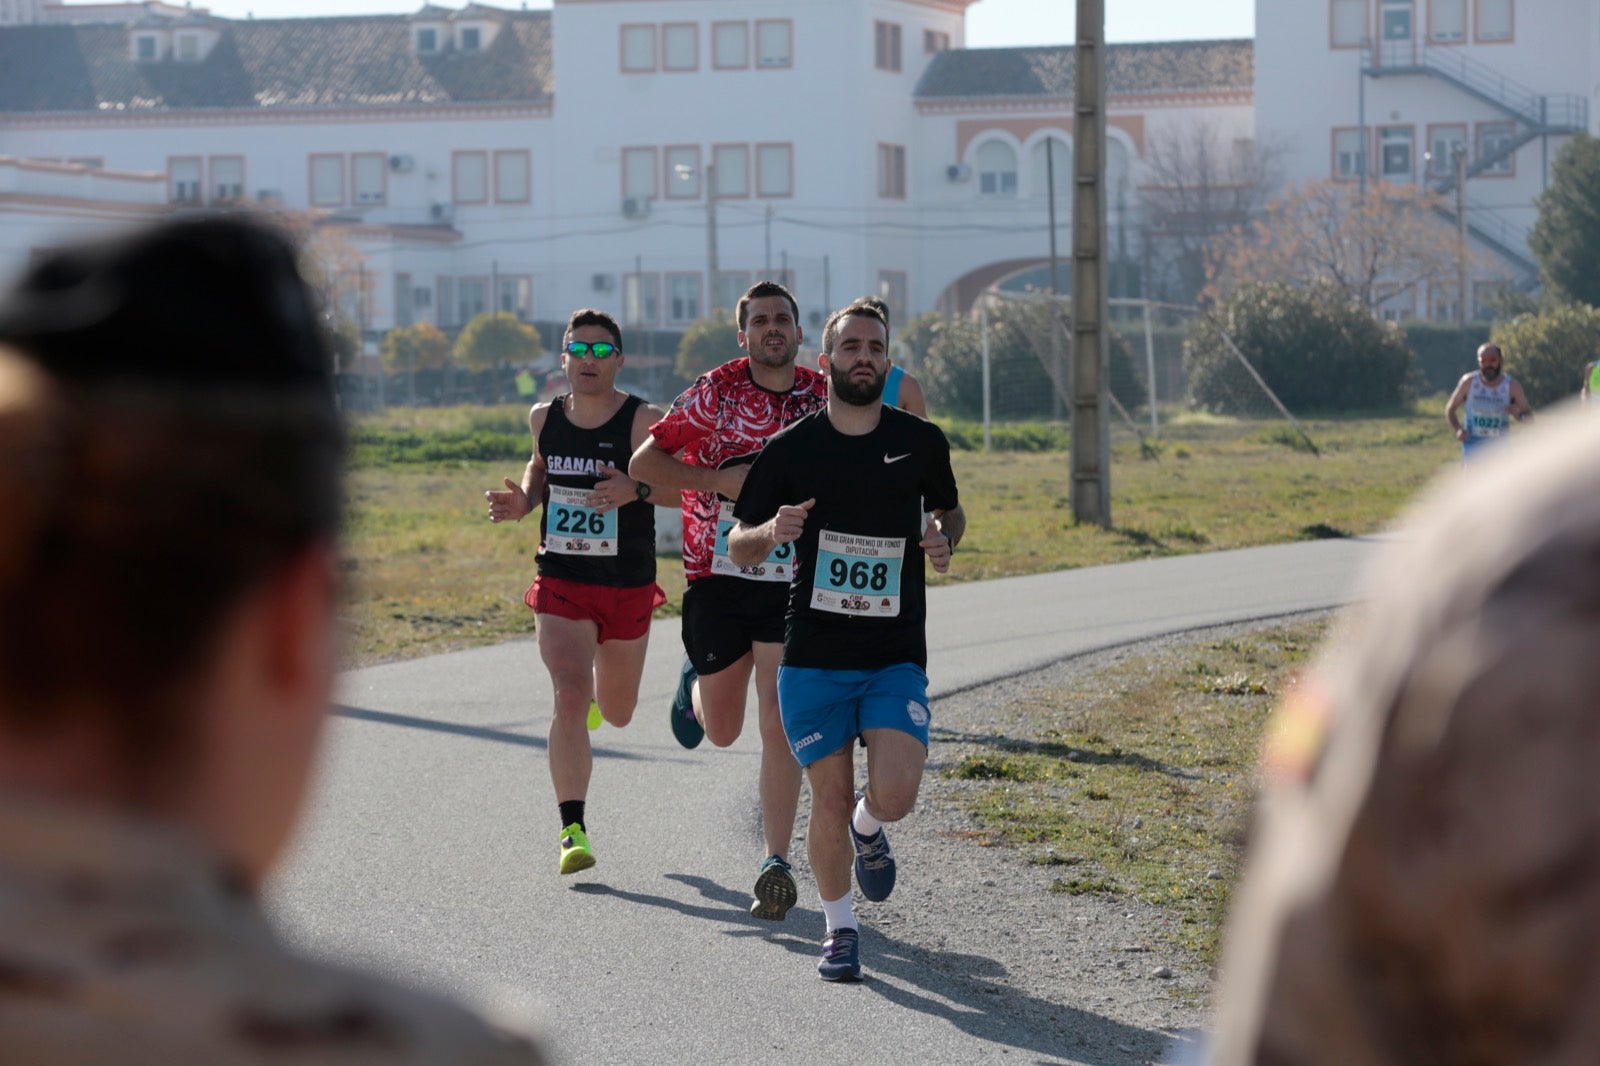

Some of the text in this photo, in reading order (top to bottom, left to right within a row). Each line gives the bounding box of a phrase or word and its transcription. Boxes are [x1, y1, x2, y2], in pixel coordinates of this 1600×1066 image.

[547, 455, 615, 473] GRANADA
[556, 508, 605, 535] 226
[839, 536, 854, 545] GRAN
[855, 538, 875, 547] PREMIO
[885, 540, 900, 548] FONDO
[829, 558, 888, 591] 968
